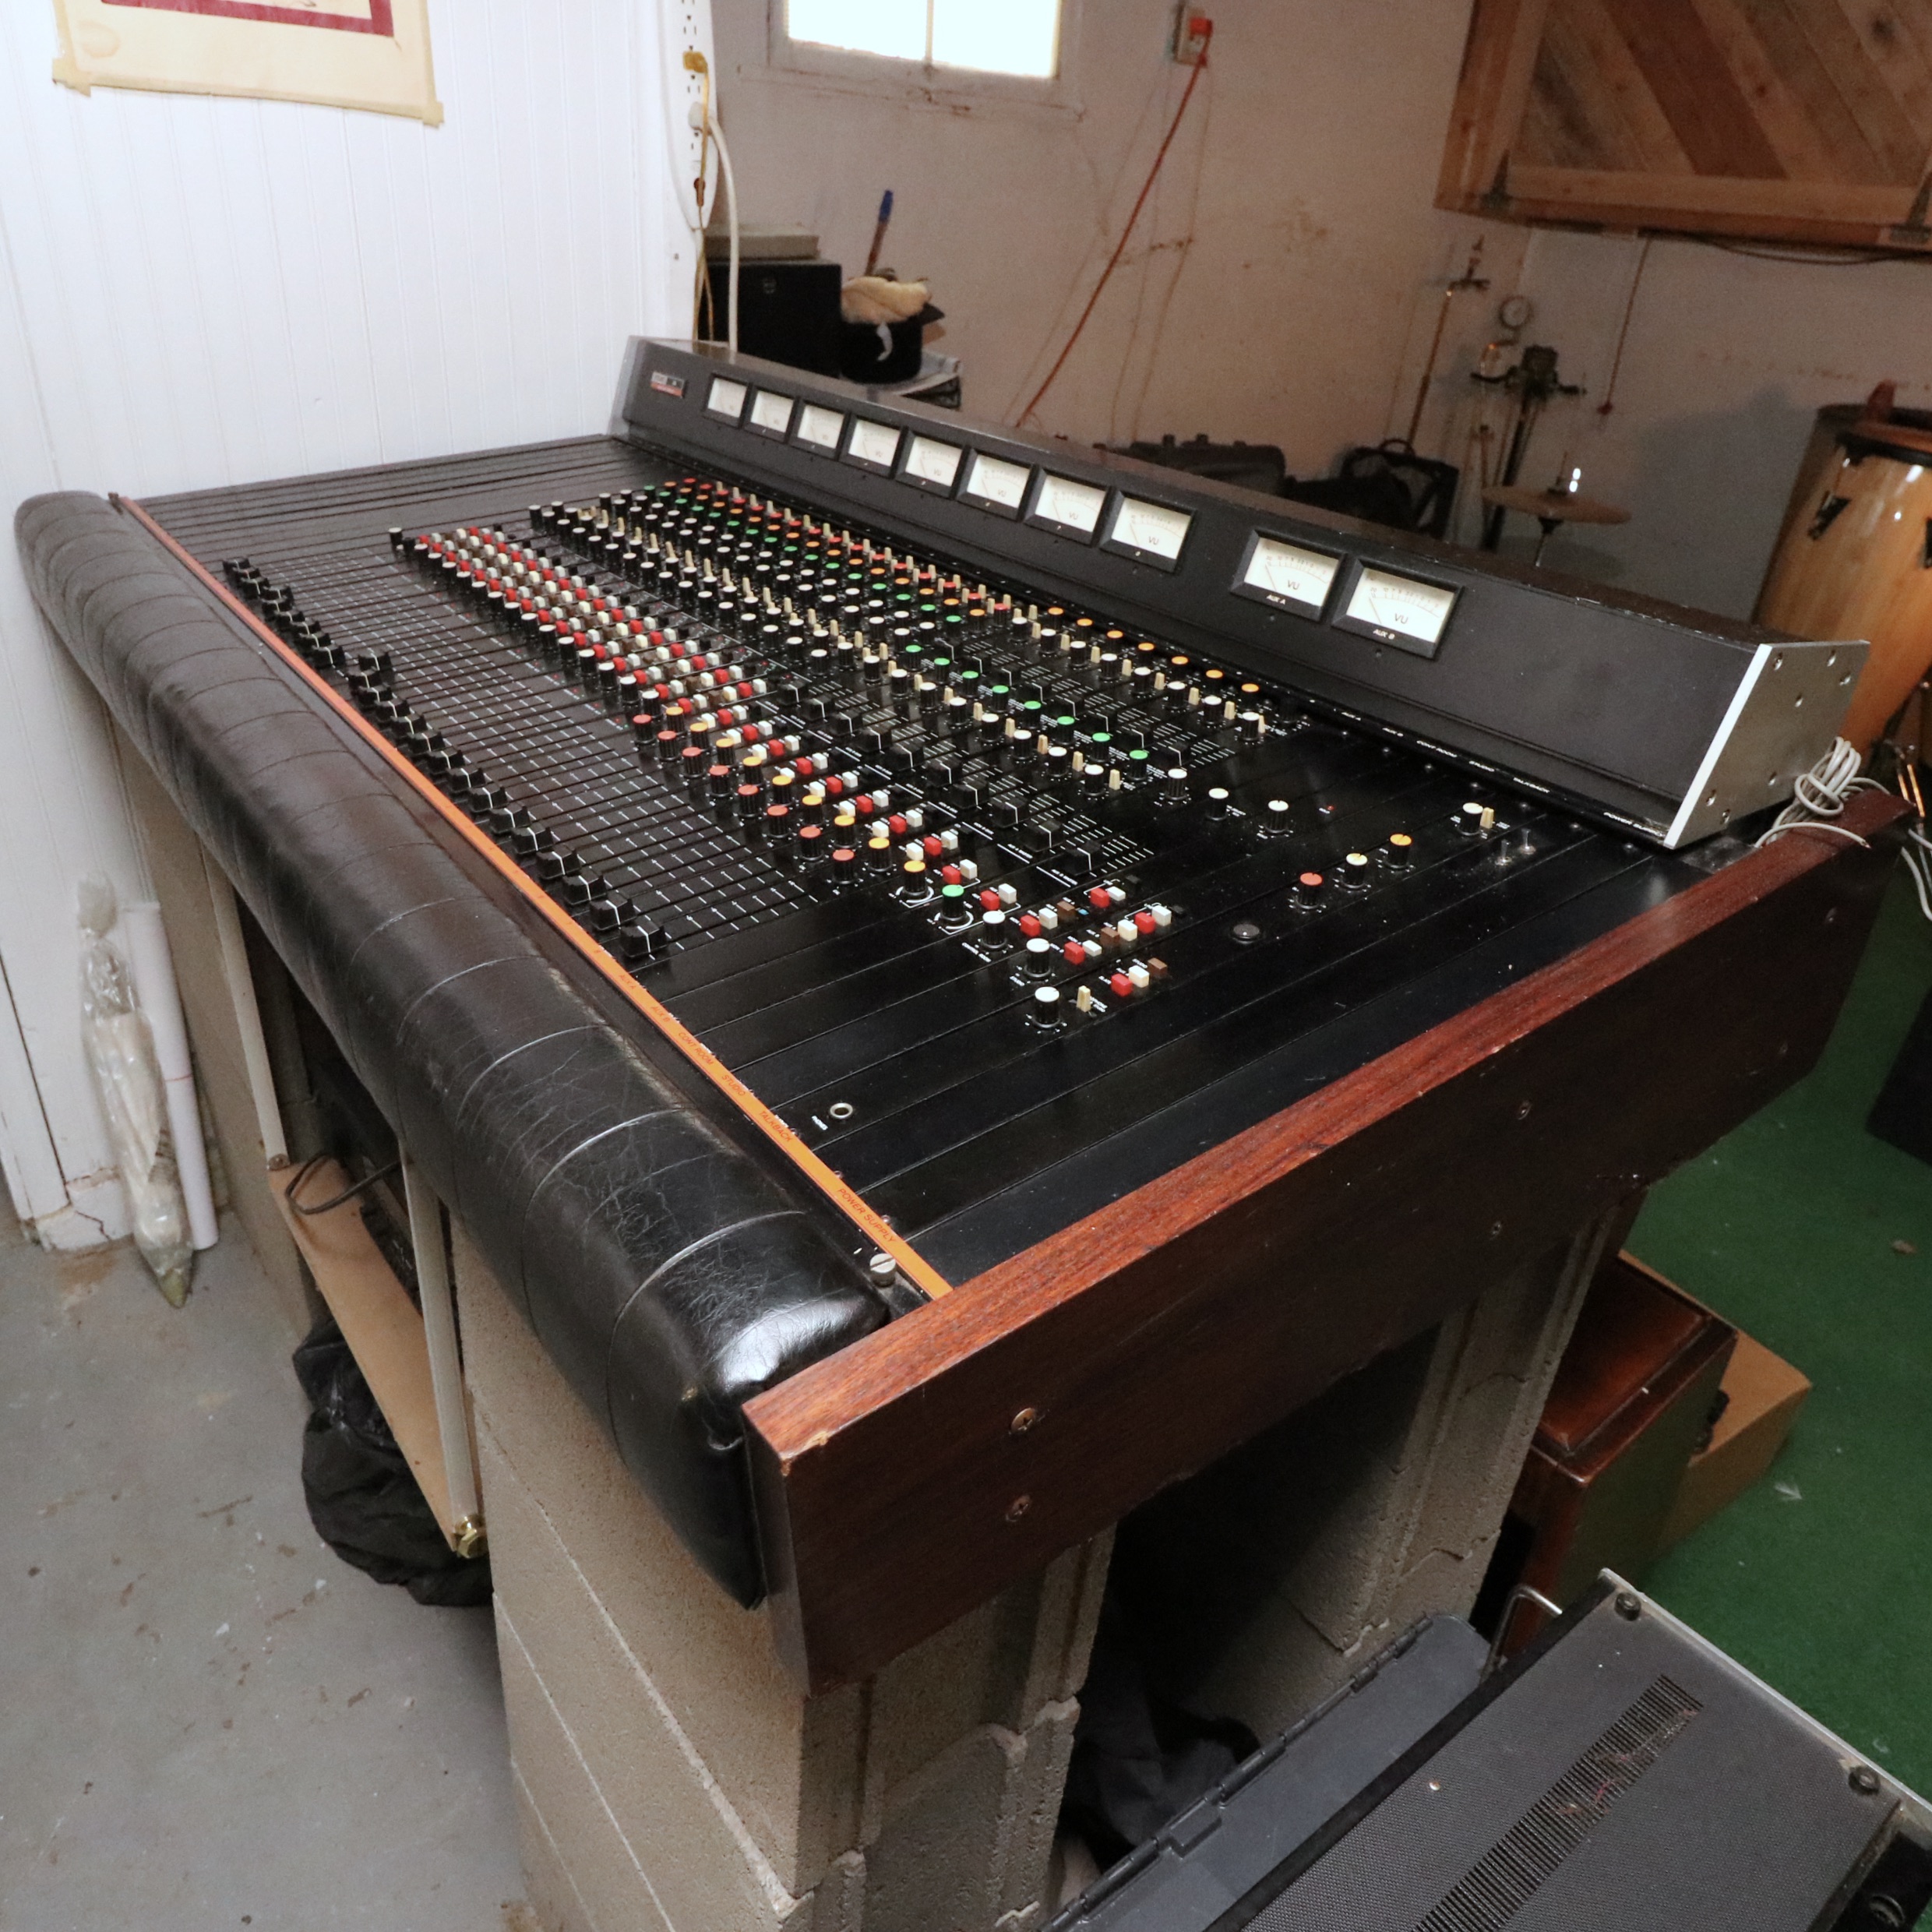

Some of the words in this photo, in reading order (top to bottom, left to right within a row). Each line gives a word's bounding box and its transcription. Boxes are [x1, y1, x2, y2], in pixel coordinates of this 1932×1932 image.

[1148, 536, 1160, 545] VU
[1287, 580, 1300, 591] VU
[1266, 594, 1280, 602] AUX
[1394, 613, 1408, 625] VU
[1373, 628, 1388, 638] AUX
[1468, 760, 1495, 772] STUDIO
[1513, 777, 1550, 794] TALKBACK
[1603, 812, 1633, 826] POWER
[679, 1031, 696, 1047] CONT
[694, 1048, 714, 1066] ROOM
[721, 1074, 746, 1096] STUDIO
[759, 1110, 794, 1143] TALKBACK
[837, 1188, 867, 1214] POWER
[863, 1214, 896, 1243] SUPPLY
